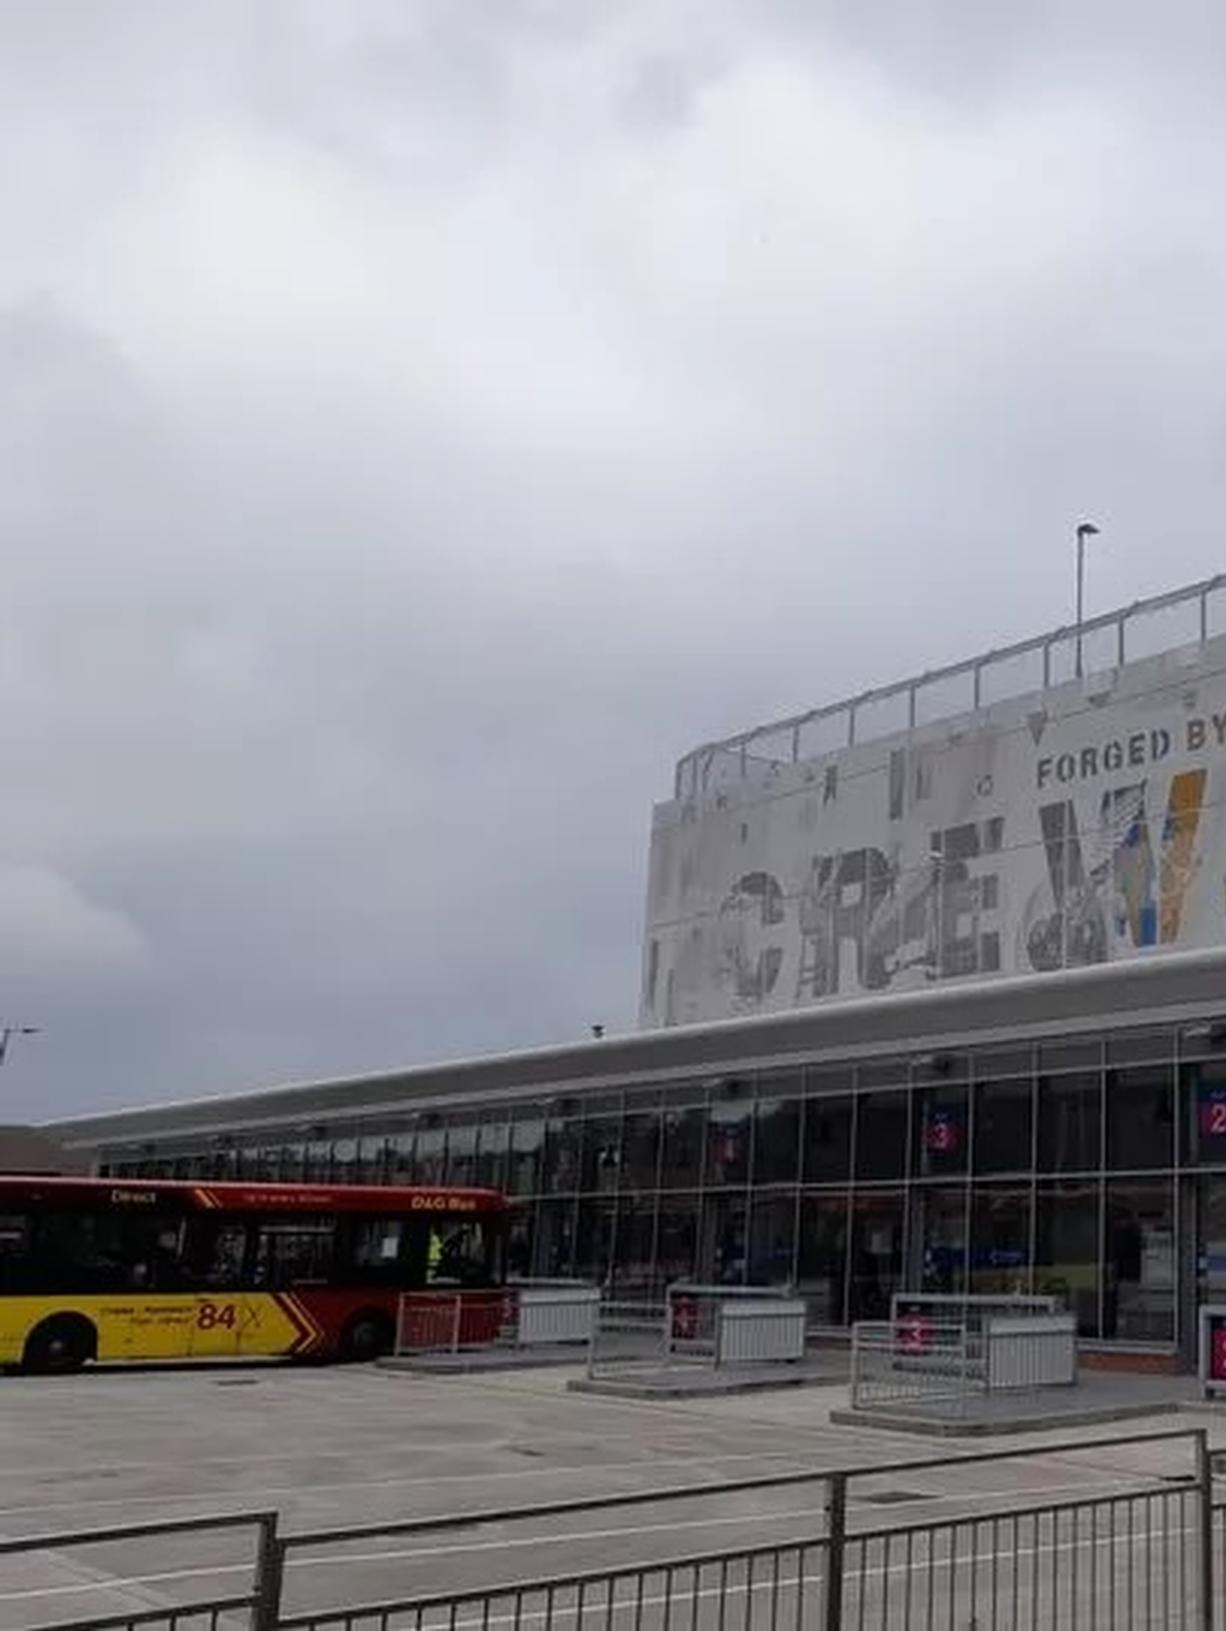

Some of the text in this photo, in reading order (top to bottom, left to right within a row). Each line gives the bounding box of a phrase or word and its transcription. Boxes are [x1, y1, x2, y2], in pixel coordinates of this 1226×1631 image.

[1036, 728, 1171, 790] FORGED
[1211, 1103, 1226, 1132] 2
[198, 1304, 235, 1330] 84
